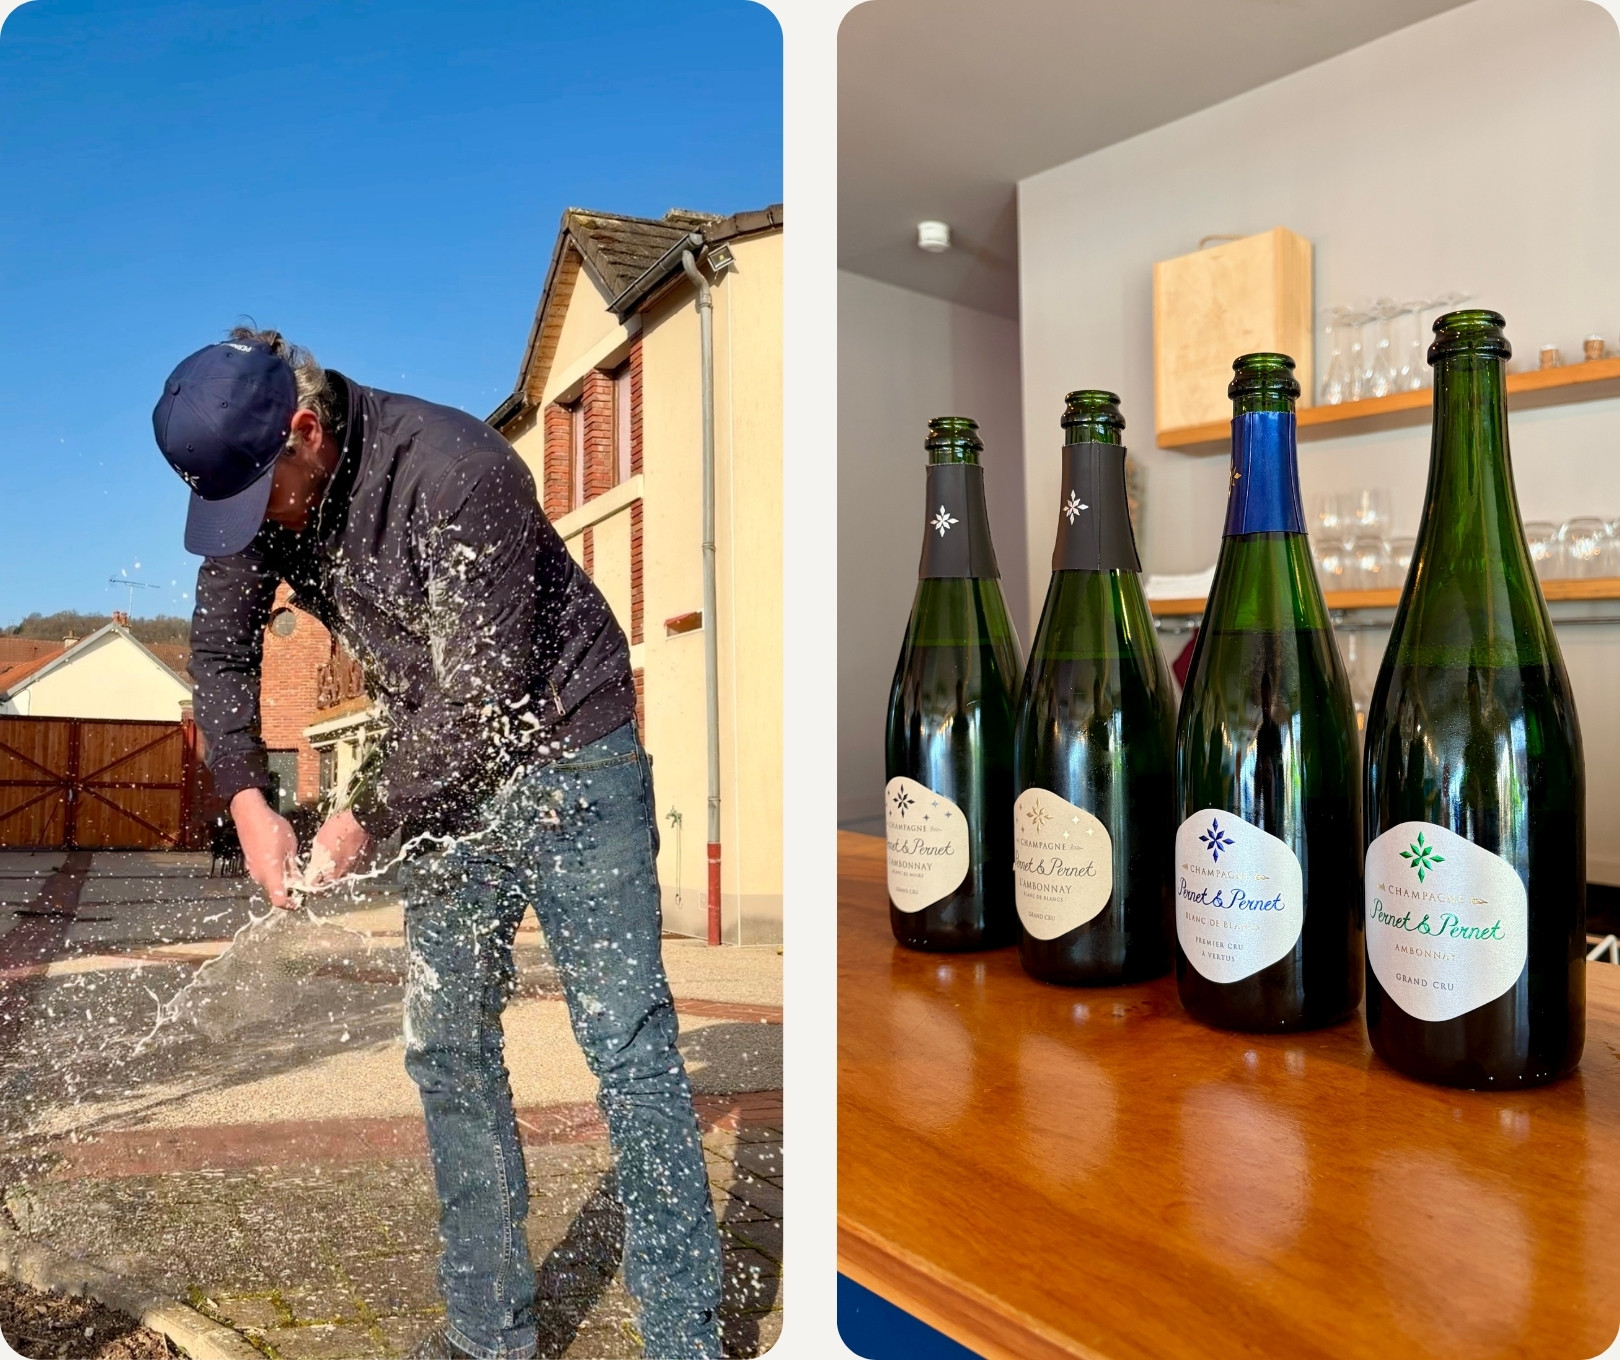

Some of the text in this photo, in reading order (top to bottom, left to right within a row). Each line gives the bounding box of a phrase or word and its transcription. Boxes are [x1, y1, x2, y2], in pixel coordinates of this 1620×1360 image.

[1020, 839, 1067, 851] CHAMPAGNE
[1190, 864, 1251, 880] CHAMPAGNE
[1019, 878, 1072, 894] L'AMBONNAY
[1388, 884, 1465, 904] CHAMPAGNE
[1028, 911, 1043, 920] GRAND
[1185, 911, 1206, 925] BLANC
[1209, 919, 1220, 927] DE
[1195, 936, 1244, 951] PREMIER CRU
[1207, 951, 1235, 963] VERTUS
[1395, 943, 1456, 961] AMBONNAY
[1395, 972, 1455, 991] GRAND CRU
